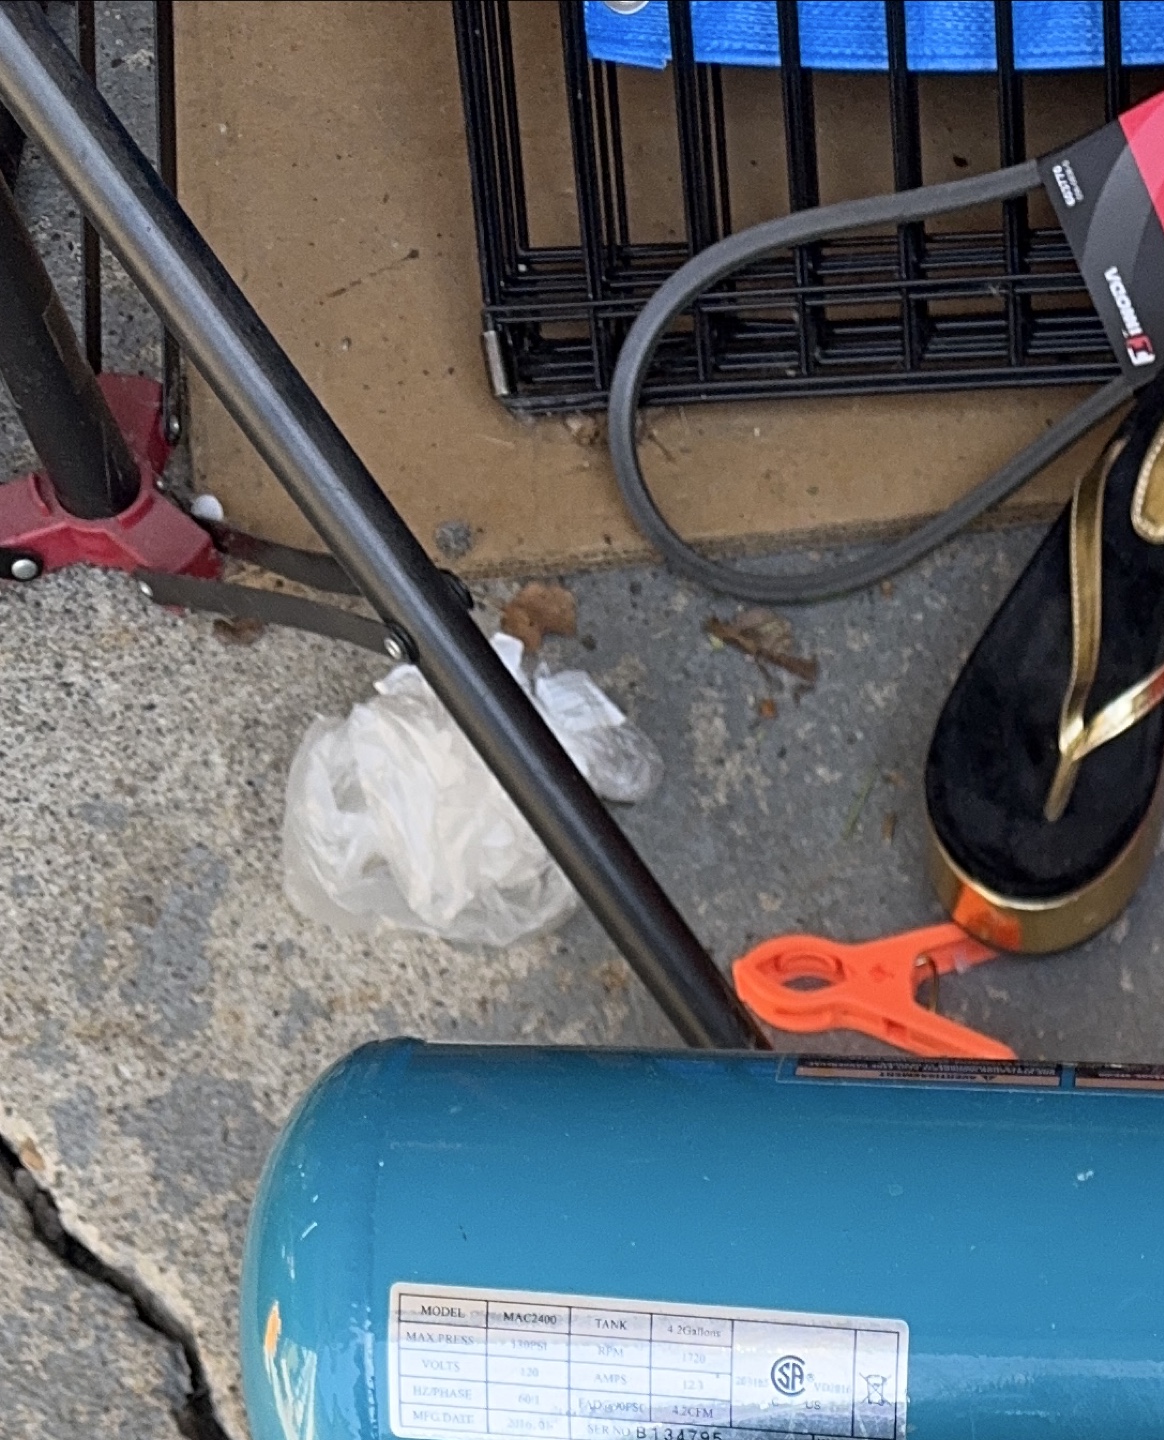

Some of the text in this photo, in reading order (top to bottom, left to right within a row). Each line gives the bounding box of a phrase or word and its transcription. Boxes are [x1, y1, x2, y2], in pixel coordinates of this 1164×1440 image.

[420, 1305, 465, 1318] MODEL
[502, 1312, 557, 1324] MAC2400
[595, 1318, 628, 1330] TANK
[598, 1346, 624, 1358] RPM
[422, 1359, 460, 1372] VOLTS
[594, 1374, 627, 1385] AMPS
[805, 1401, 821, 1410] US
